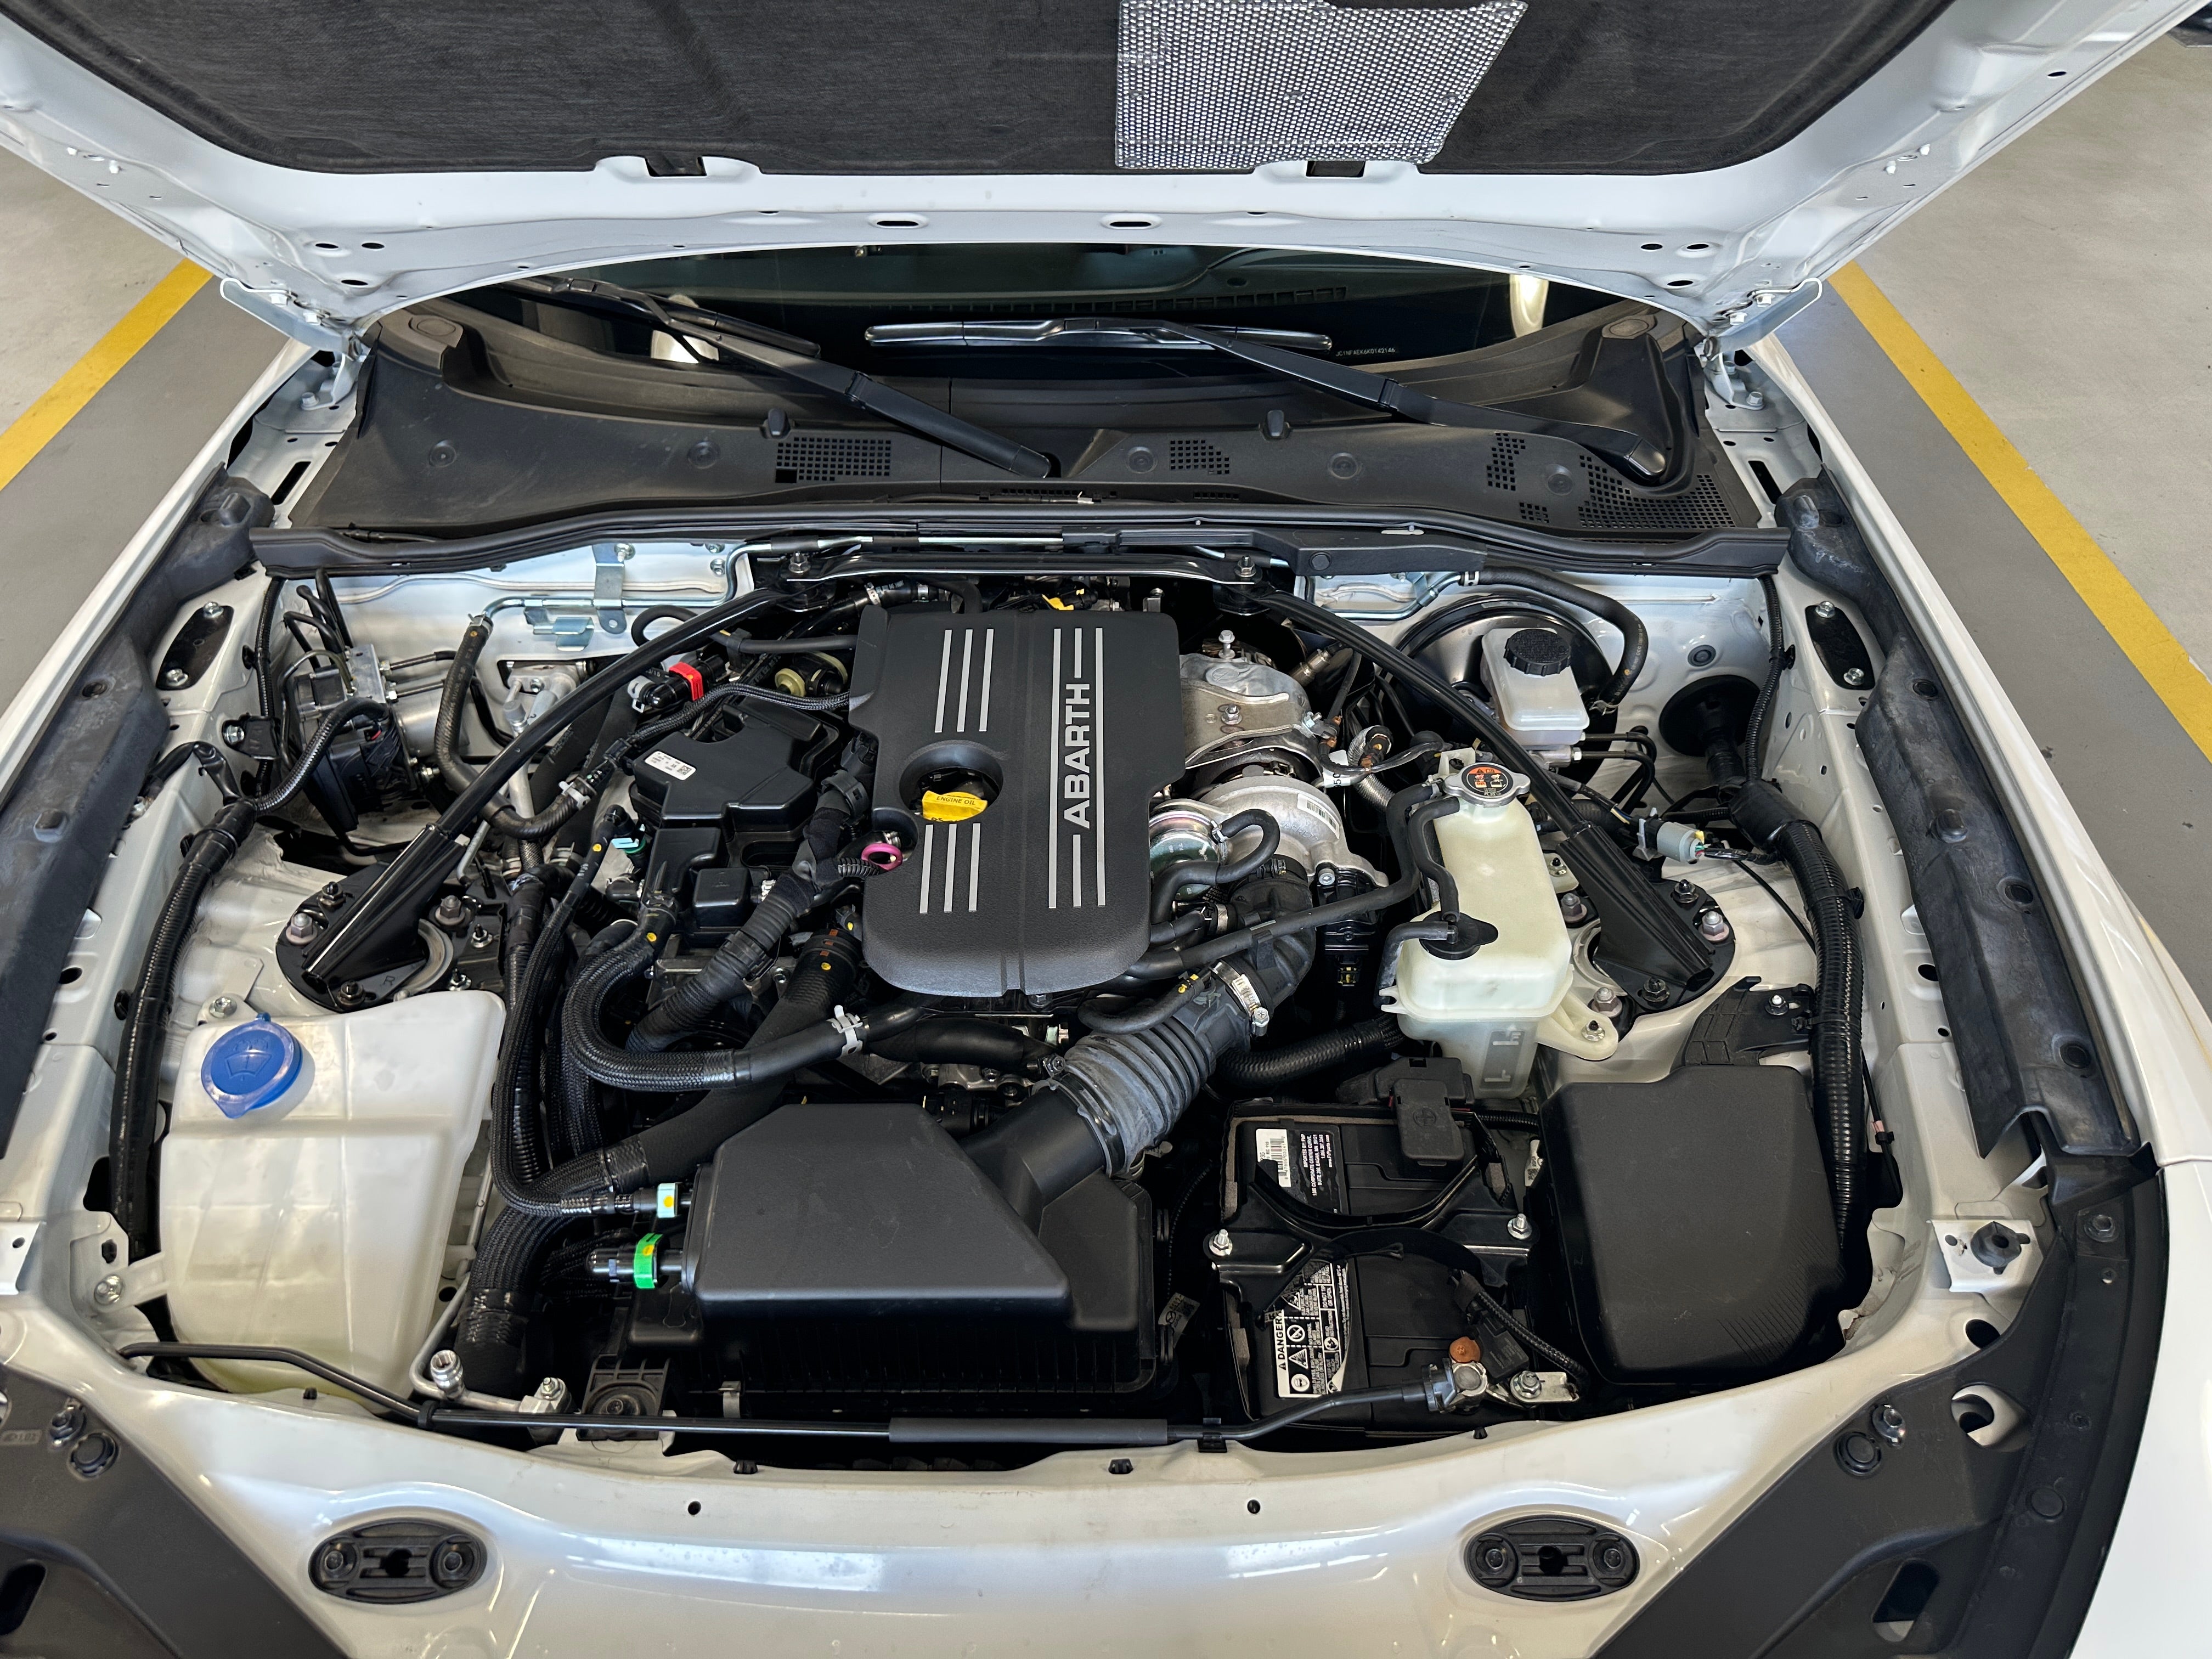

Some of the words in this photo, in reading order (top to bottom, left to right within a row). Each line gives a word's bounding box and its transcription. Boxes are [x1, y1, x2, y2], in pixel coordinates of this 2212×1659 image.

[1064, 684, 1091, 830] ABARTH
[936, 795, 963, 804] ENGINE
[1276, 1318, 1285, 1360] DANGER
